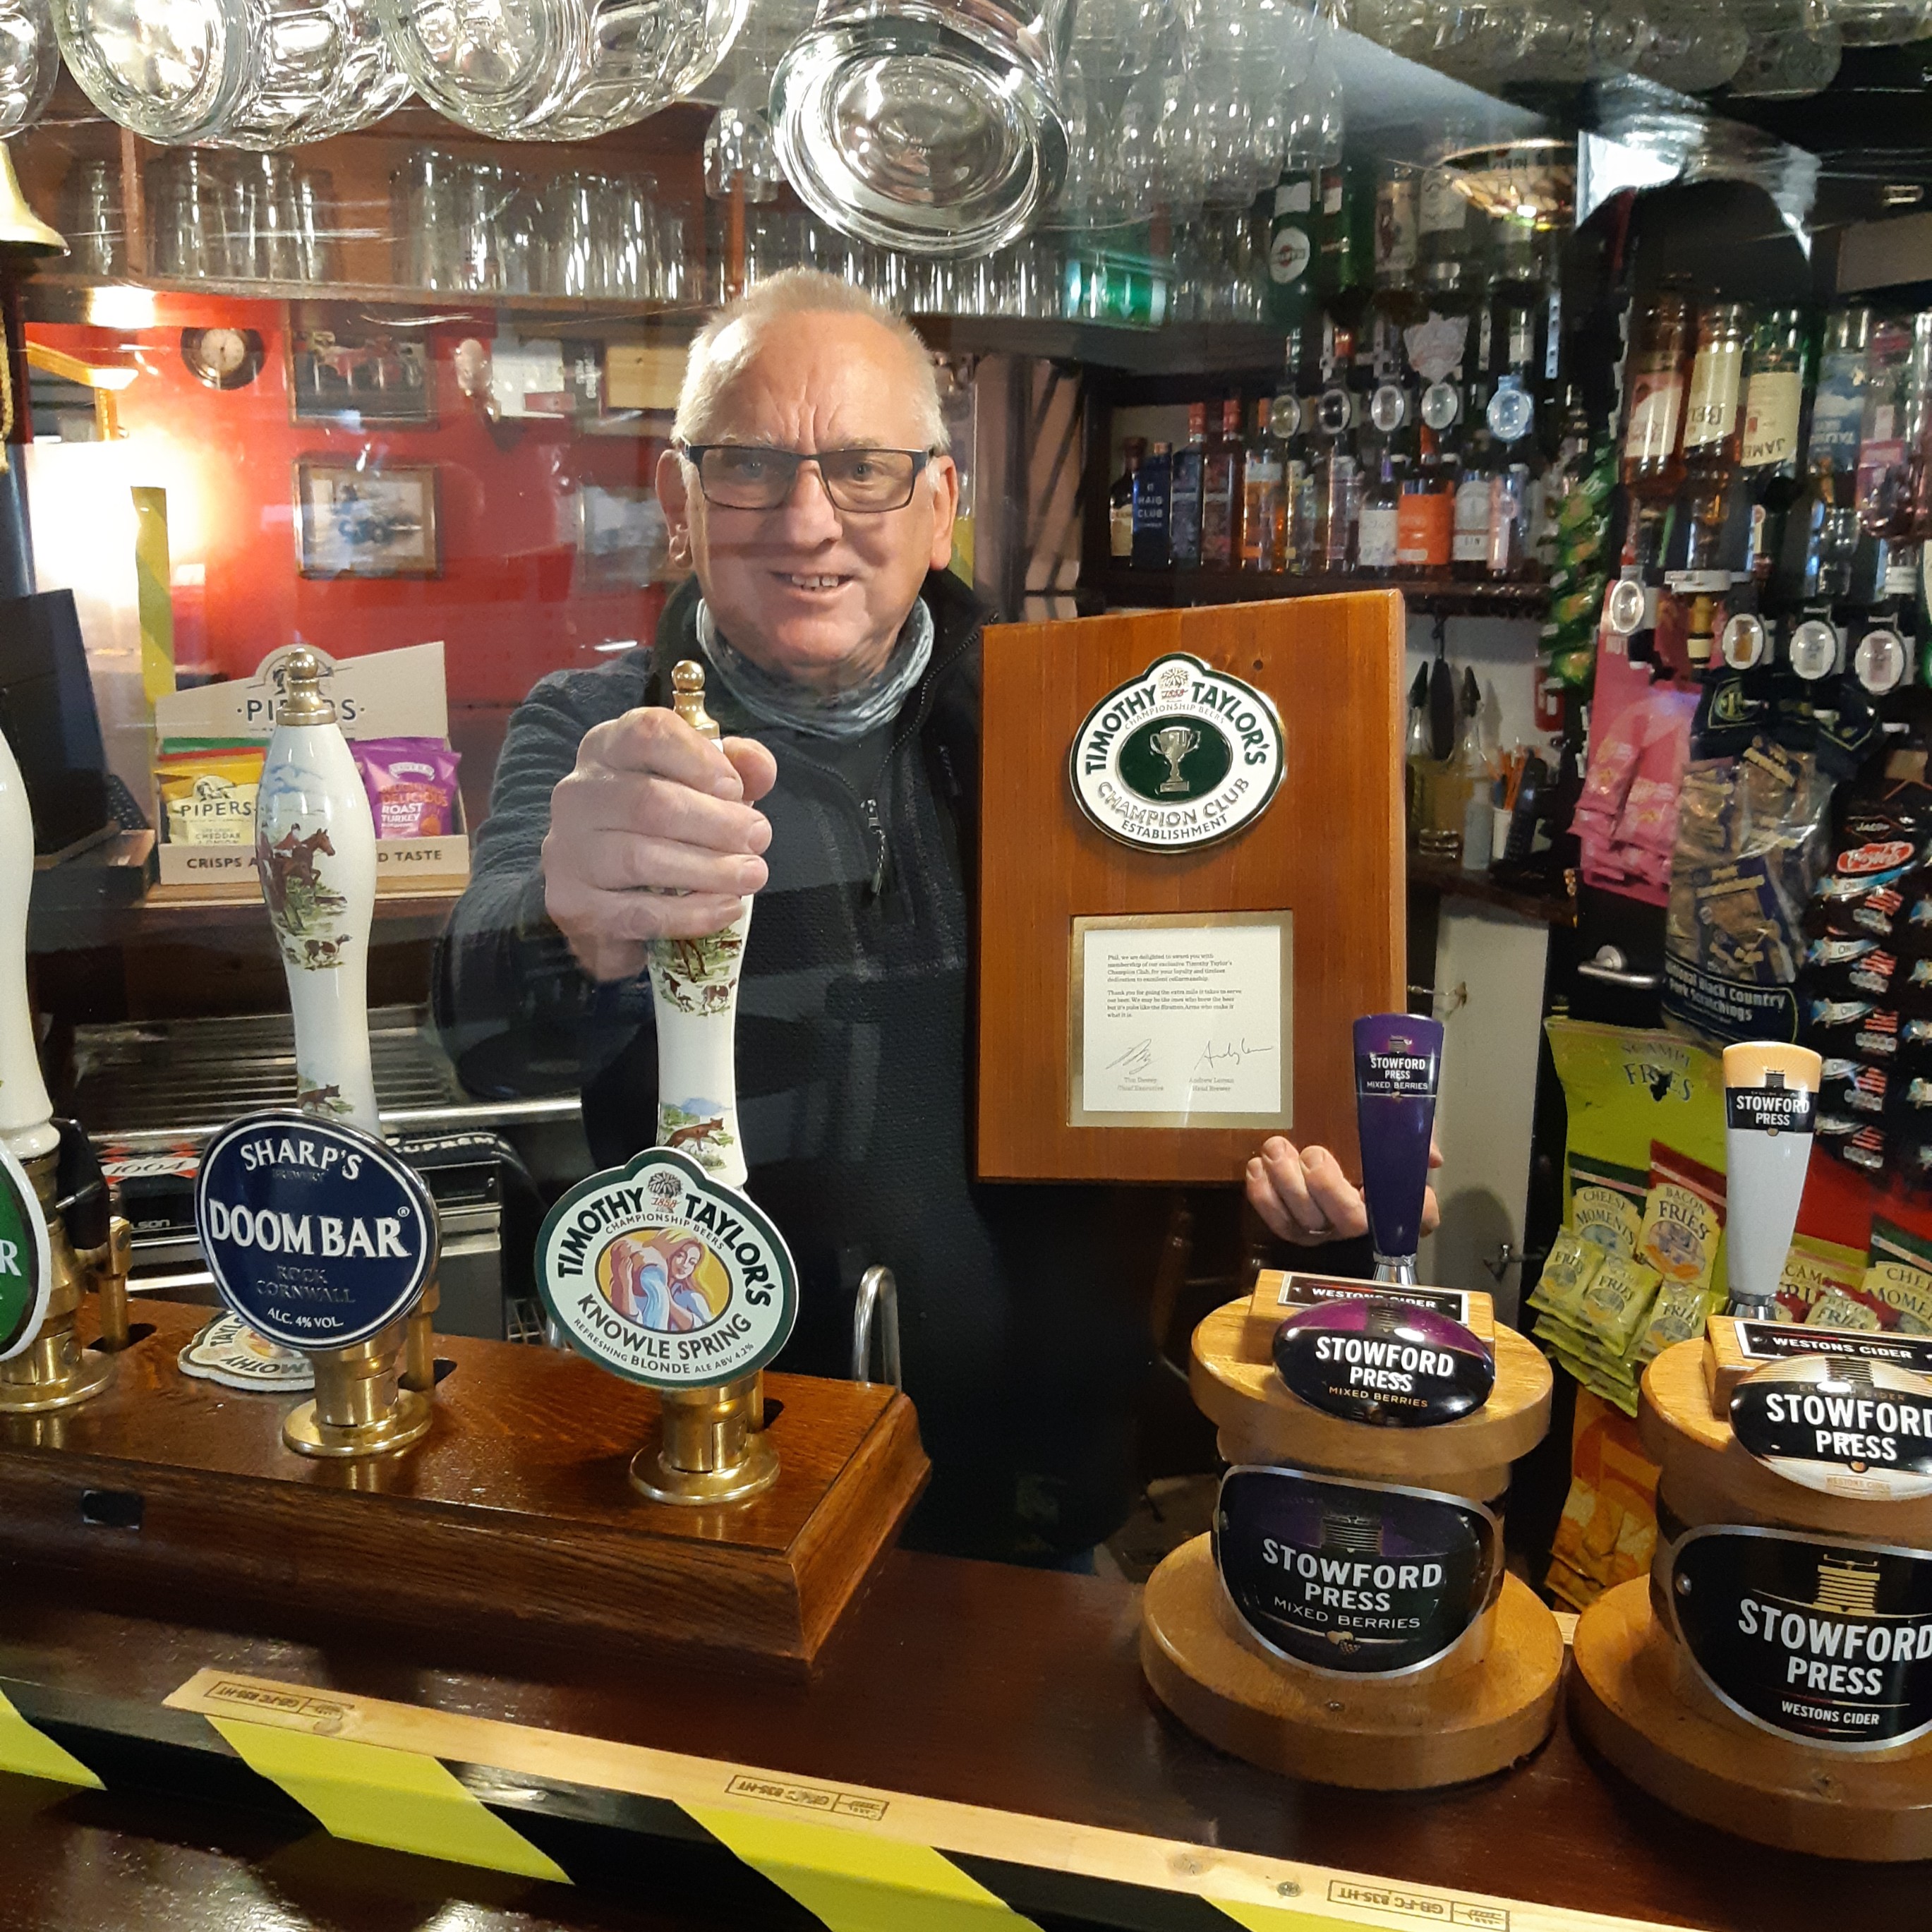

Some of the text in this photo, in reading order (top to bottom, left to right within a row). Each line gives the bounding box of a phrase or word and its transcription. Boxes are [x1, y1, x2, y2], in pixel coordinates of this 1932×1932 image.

[1746, 438, 1786, 454] JAME
[247, 699, 356, 721] PIS
[1125, 703, 1225, 730] CHAMPIONSHIP BEERS
[1085, 681, 1271, 775] TIMOTHY TAYLOR'S
[181, 801, 252, 817] PIPERS
[382, 803, 423, 814] ROAST
[1097, 777, 1250, 827] CHAMPION CLUB
[382, 814, 421, 823] TURKEY
[1121, 814, 1228, 840] ESTABLISHMENT
[187, 857, 242, 869] CRISPS
[394, 850, 442, 862] TASTE
[1729, 989, 1785, 1009] Country
[1370, 1058, 1426, 1070] STOWFORD
[1384, 1070, 1411, 1080] PRESS
[1394, 1082, 1428, 1090] BERRIES
[1623, 1063, 1691, 1101] FRES
[1736, 1095, 1810, 1113] STOWFORD
[1755, 1112, 1790, 1126] PRESS
[240, 1137, 364, 1181] SHARP'S
[652, 1197, 678, 1208] 1858
[1583, 1190, 1626, 1211] CHEESE
[1665, 1187, 1707, 1216] BACON
[209, 1198, 412, 1258] DOOM BAR
[605, 1212, 725, 1250] CHAMPIONSHIP BEERS
[1575, 1208, 1635, 1246] MOMENTS
[1659, 1200, 1712, 1240] FRIES
[558, 1187, 775, 1307] TIMOTHY TAYLOR'S
[1781, 1264, 1823, 1284] CAM
[255, 1280, 356, 1303] CORNWALL
[1599, 1275, 1636, 1302] FRIES
[267, 1308, 293, 1324] ALC.
[295, 1316, 313, 1328] 4%
[576, 1293, 753, 1360] KNOWLE SPRING
[210, 1317, 247, 1347] TAYL
[574, 1317, 754, 1375] REFRESHING BLONDE ALE ABV 4.2%
[1315, 1336, 1454, 1377] STOWFORD
[1773, 1337, 1913, 1359] WESTONS CIDER
[1349, 1366, 1413, 1393] PRESS
[1329, 1386, 1429, 1408] MIXED BERRIES
[1815, 1430, 1898, 1461] PRESS
[1262, 1538, 1442, 1589] STOWFORD
[1305, 1582, 1391, 1612] PRESS
[1274, 1596, 1421, 1629] MIXED BERRIES
[1738, 1598, 1932, 1662] STOWFORD
[1787, 1655, 1884, 1696] PRESS
[1782, 1700, 1880, 1726] WESTONS CIDER
[1337, 1887, 1444, 1915] GB-FC 835-HT
